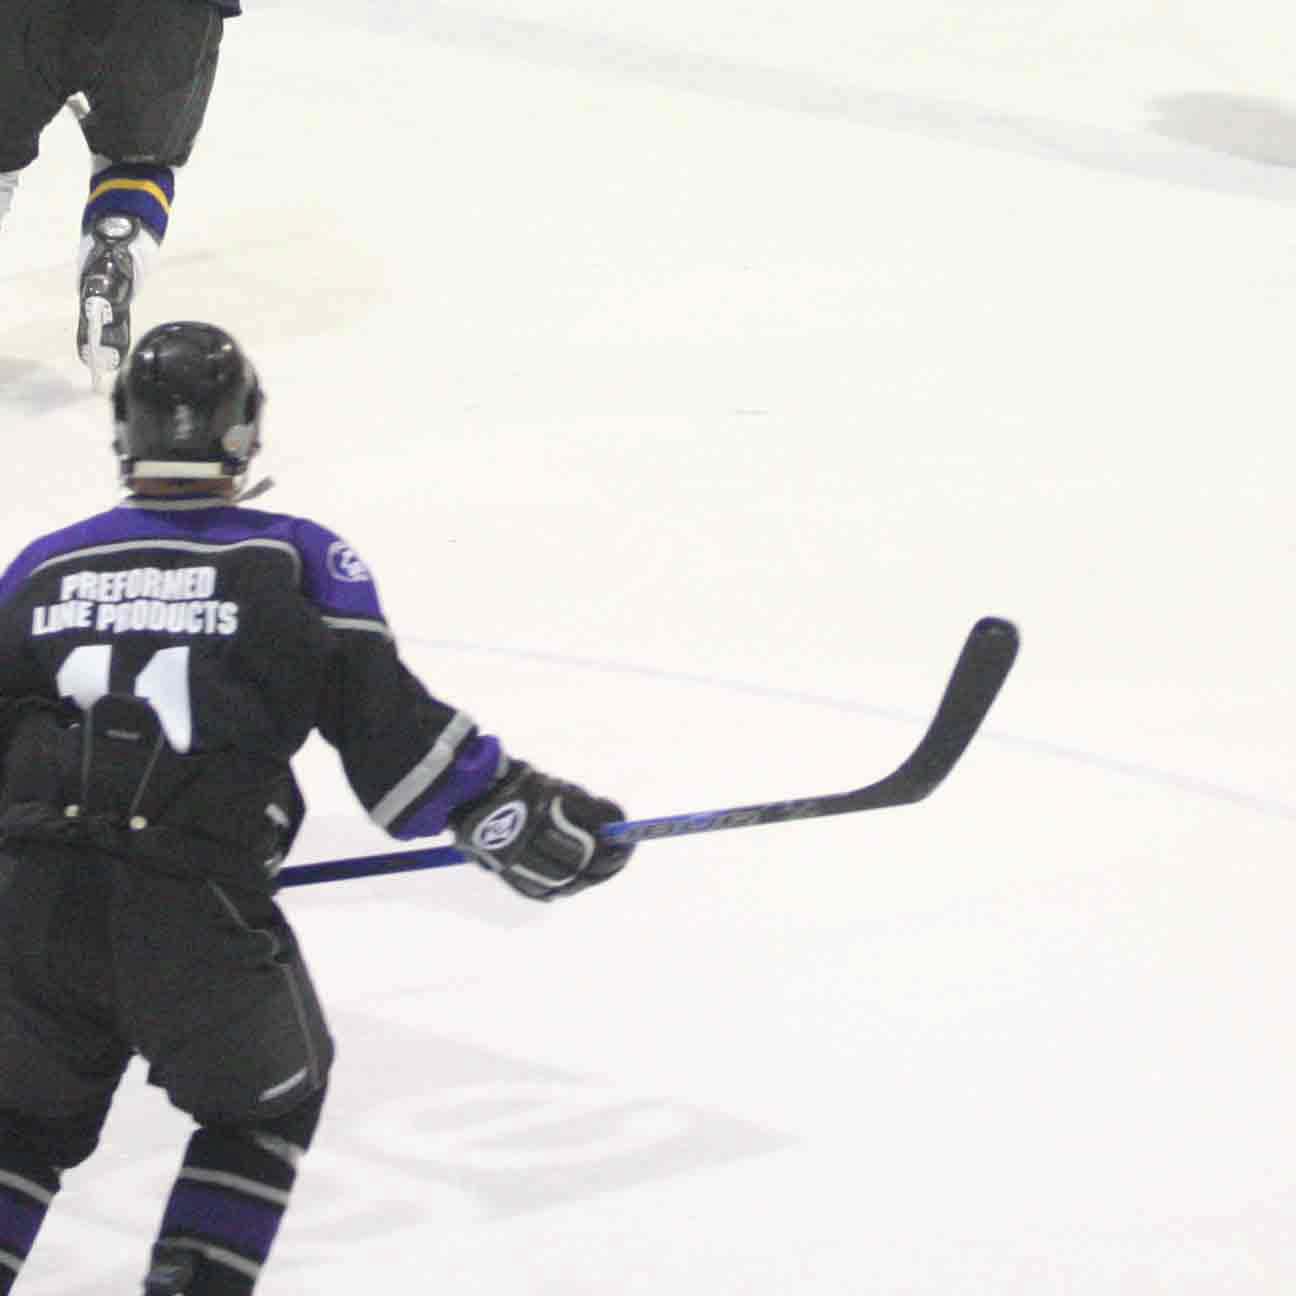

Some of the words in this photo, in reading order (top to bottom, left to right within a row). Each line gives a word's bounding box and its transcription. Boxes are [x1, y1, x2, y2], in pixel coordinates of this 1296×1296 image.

[60, 565, 217, 603] PREFORMED
[31, 601, 95, 636] LINE
[95, 600, 239, 636] PRODUCTS
